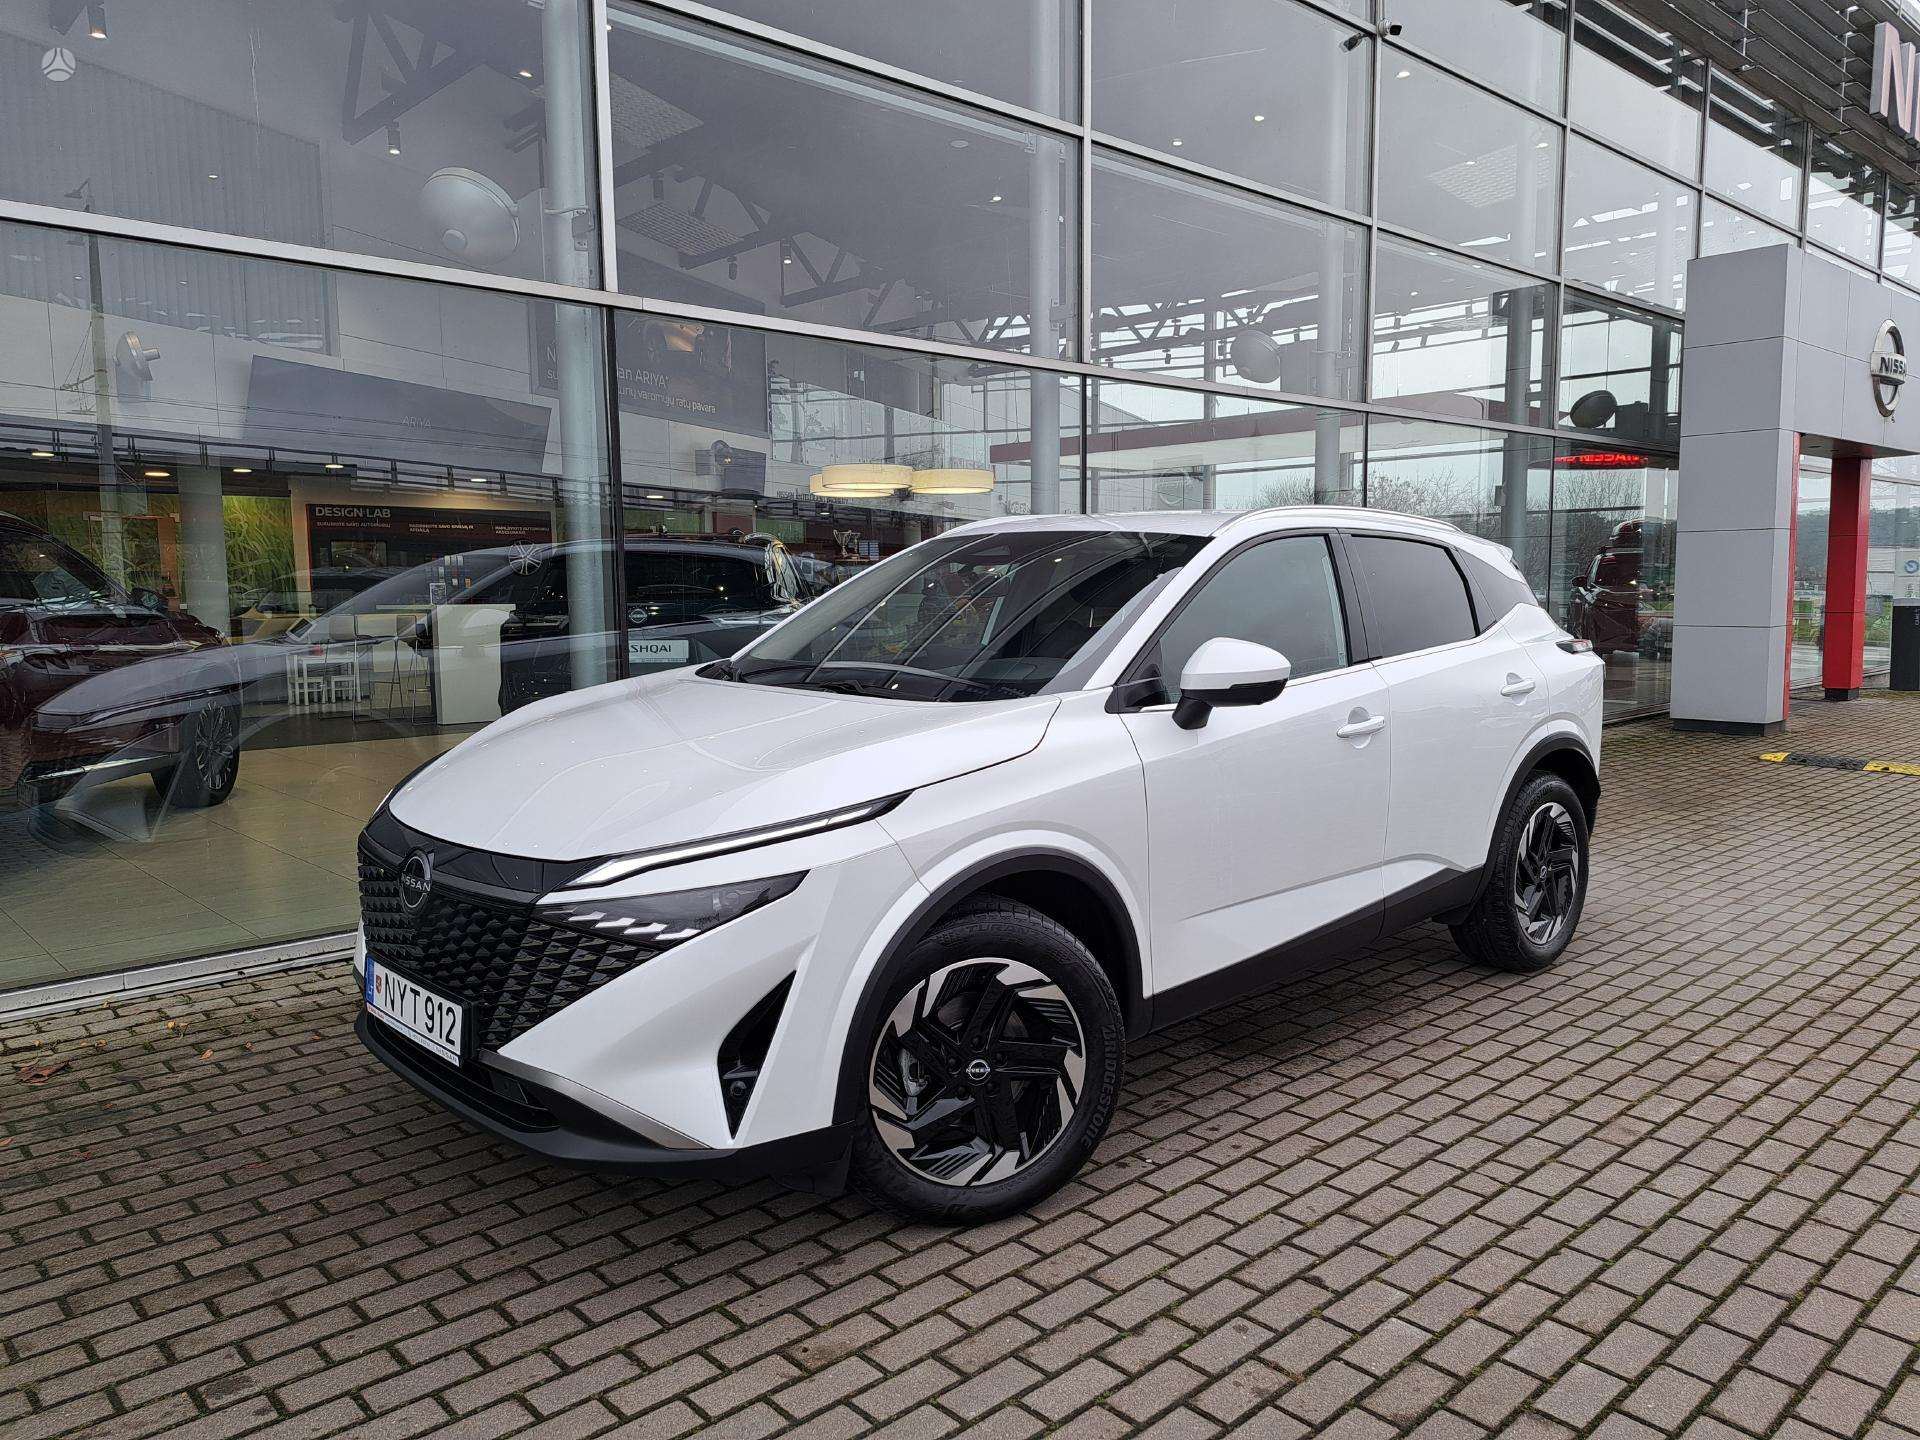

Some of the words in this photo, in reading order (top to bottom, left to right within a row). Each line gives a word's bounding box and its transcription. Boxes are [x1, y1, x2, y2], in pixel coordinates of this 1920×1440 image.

[692, 401, 716, 413] pavara
[315, 506, 363, 518] DESIGN
[366, 508, 391, 518] LAB
[384, 972, 421, 1025] NYT
[425, 995, 457, 1047] 912
[1080, 1024, 1117, 1149] BRIDGESTONE
